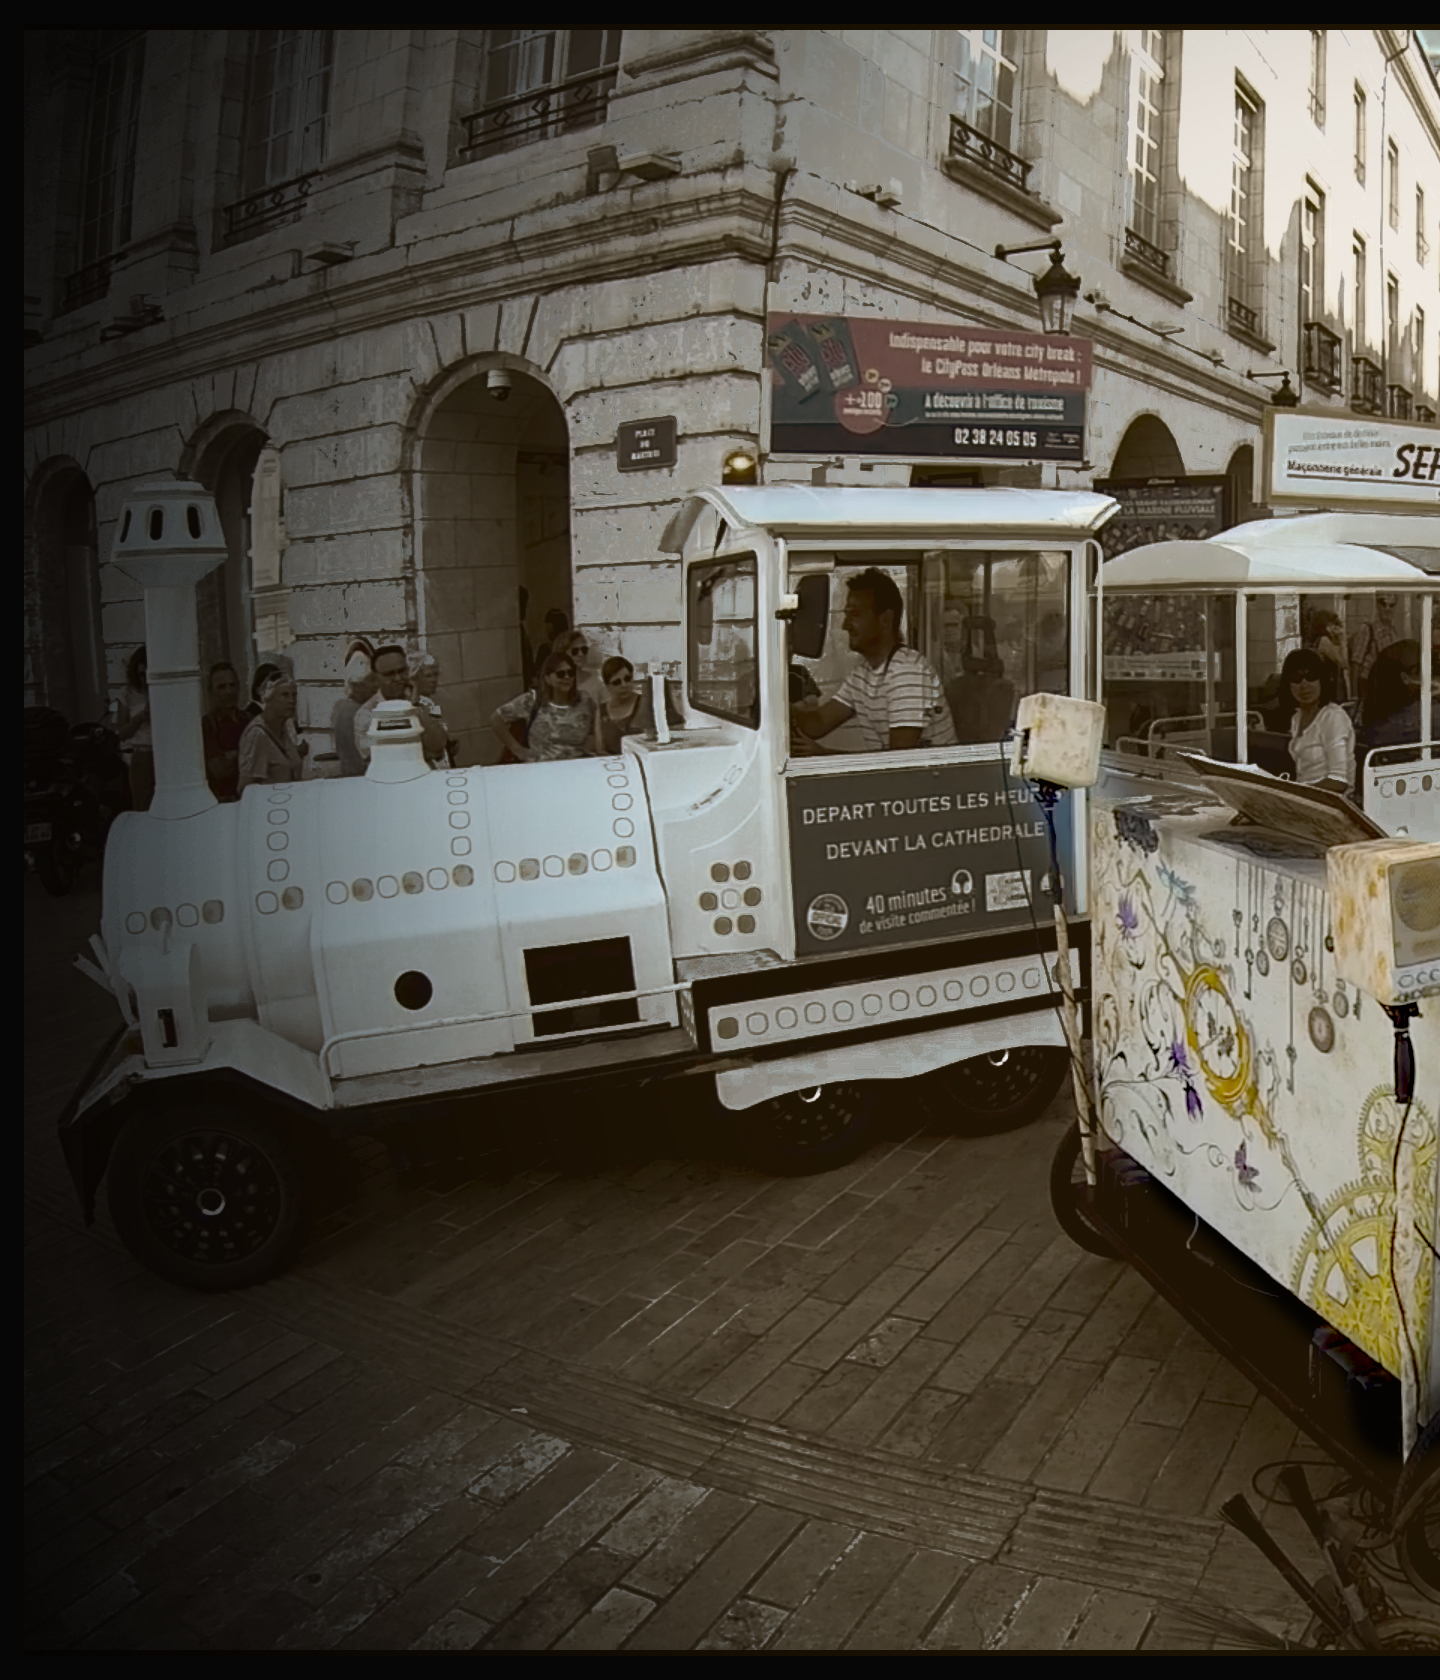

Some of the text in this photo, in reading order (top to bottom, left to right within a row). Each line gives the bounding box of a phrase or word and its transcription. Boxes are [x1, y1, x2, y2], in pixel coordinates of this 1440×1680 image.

[889, 331, 966, 353] Indispensable
[968, 340, 992, 358] pour
[995, 342, 1023, 357] votre
[1024, 344, 1044, 363] city
[1046, 345, 1076, 362] break
[921, 356, 932, 374] le
[954, 427, 970, 444] 02
[972, 428, 987, 444] 38
[989, 428, 1004, 446] 24
[1006, 429, 1020, 446] 05
[1022, 430, 1038, 447] 05
[803, 802, 875, 826] DEPART
[880, 796, 951, 816] TOUTES
[956, 792, 988, 810] LES
[826, 821, 1045, 860] DEVANT LA CATHEDRALE
[866, 886, 946, 915] 40 minutes
[859, 919, 874, 935] de
[875, 911, 906, 932] visite
[908, 900, 970, 926] commentée
